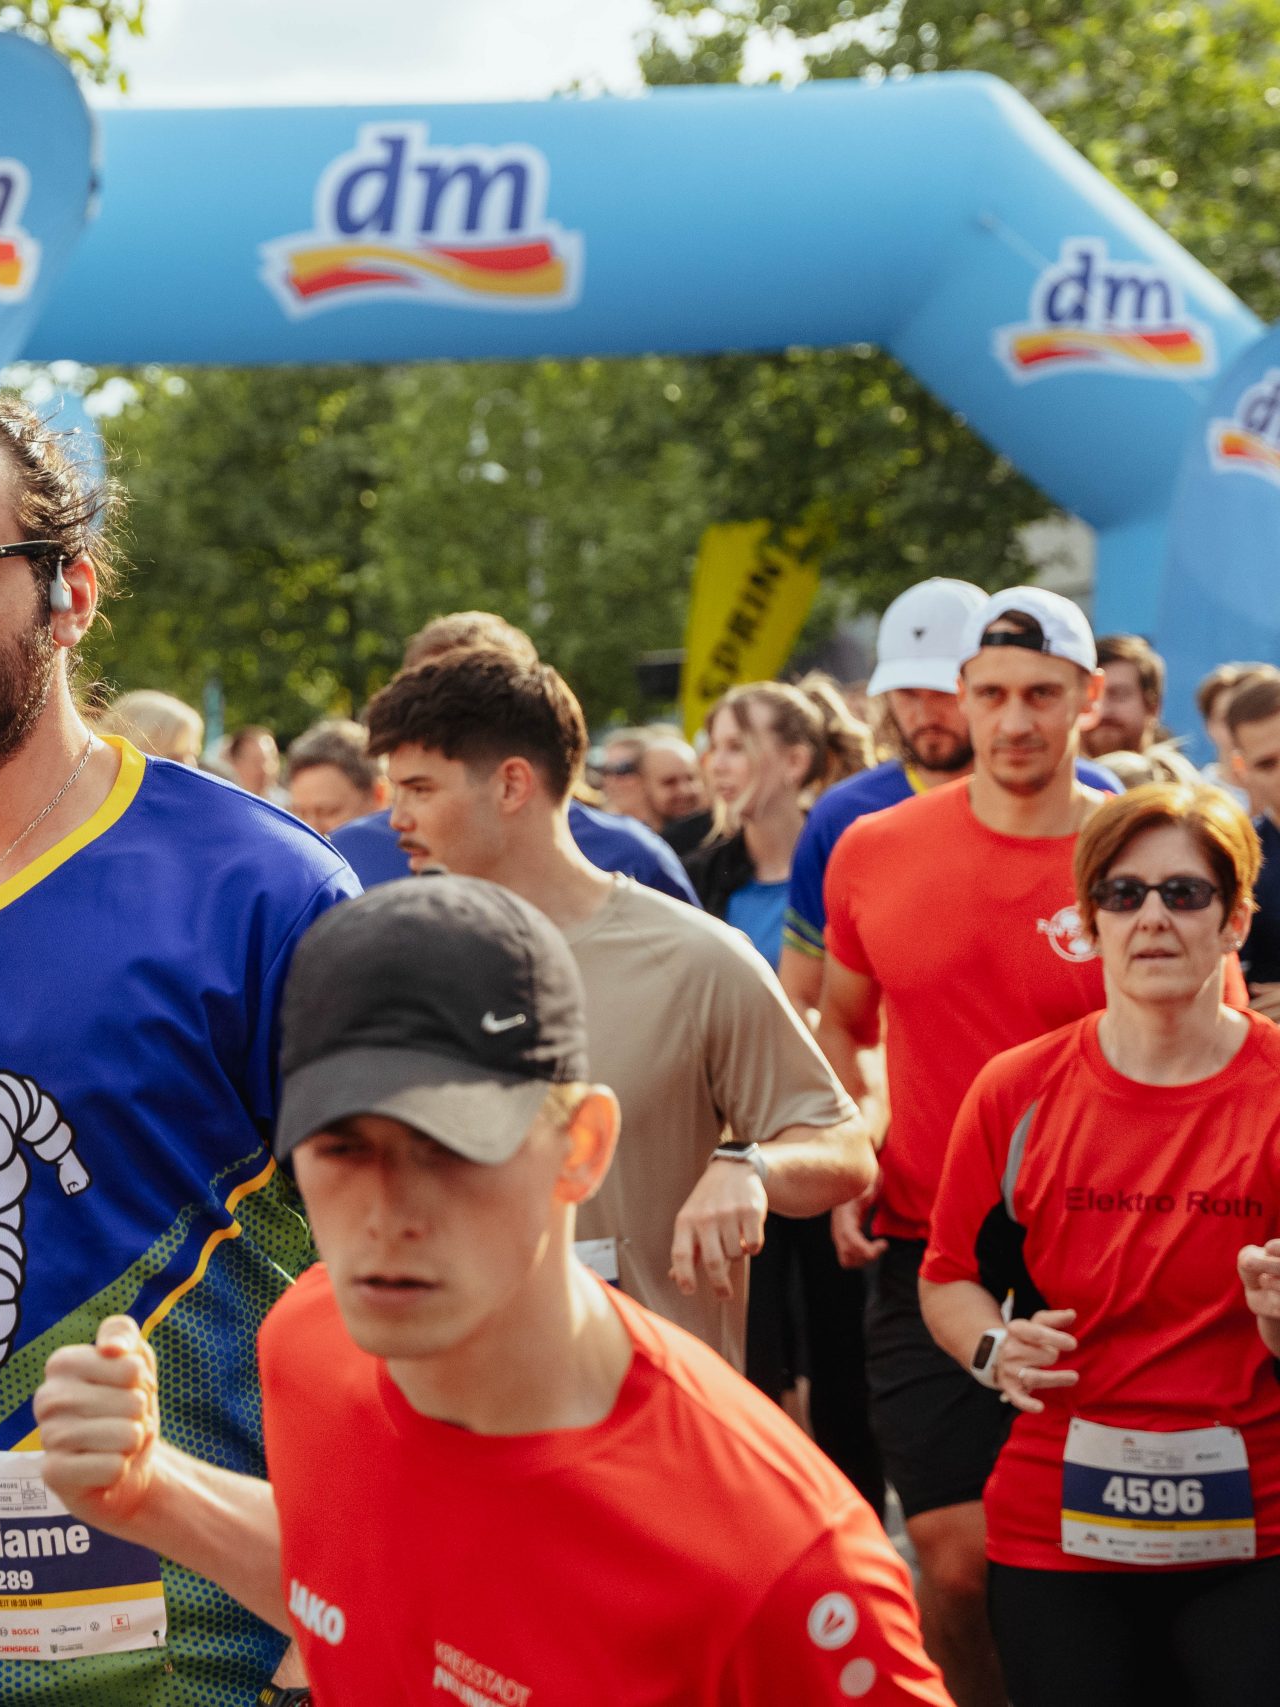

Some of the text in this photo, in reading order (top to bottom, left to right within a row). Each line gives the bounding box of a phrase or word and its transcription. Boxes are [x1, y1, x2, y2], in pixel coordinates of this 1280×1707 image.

[335, 135, 530, 235] dm
[1045, 251, 1173, 324] dm
[1064, 1186, 1263, 1217] Elektro Roth
[1102, 1475, 1205, 1516] 4596
[28, 1598, 43, 1607] UHR
[288, 1579, 346, 1646] JAKO
